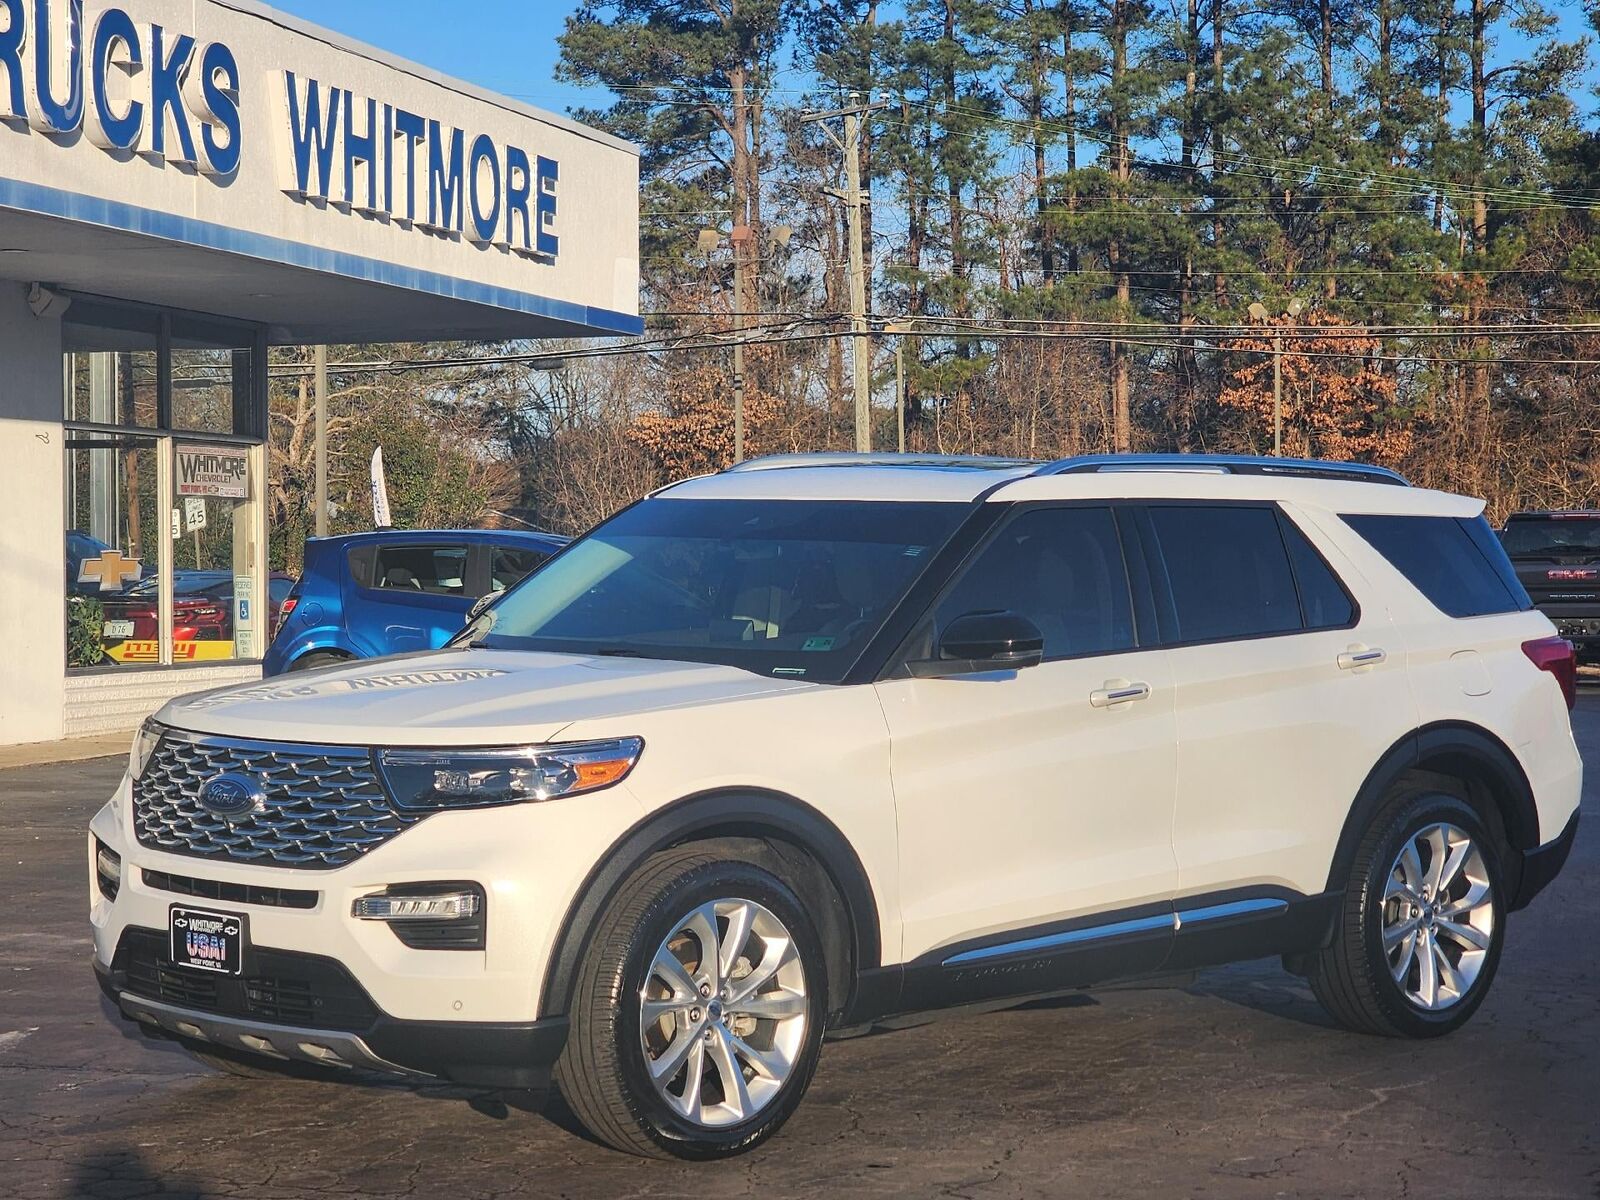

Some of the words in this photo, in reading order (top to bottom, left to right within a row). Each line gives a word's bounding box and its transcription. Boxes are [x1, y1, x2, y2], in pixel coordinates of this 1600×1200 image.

[284, 69, 560, 258] WHITMORE
[180, 454, 246, 483] WHITMORE
[196, 474, 231, 483] CHEVROLET
[189, 510, 204, 525] 45
[207, 783, 239, 804] Ford
[188, 918, 224, 933] WHITMORE
[186, 931, 226, 961] USA1
